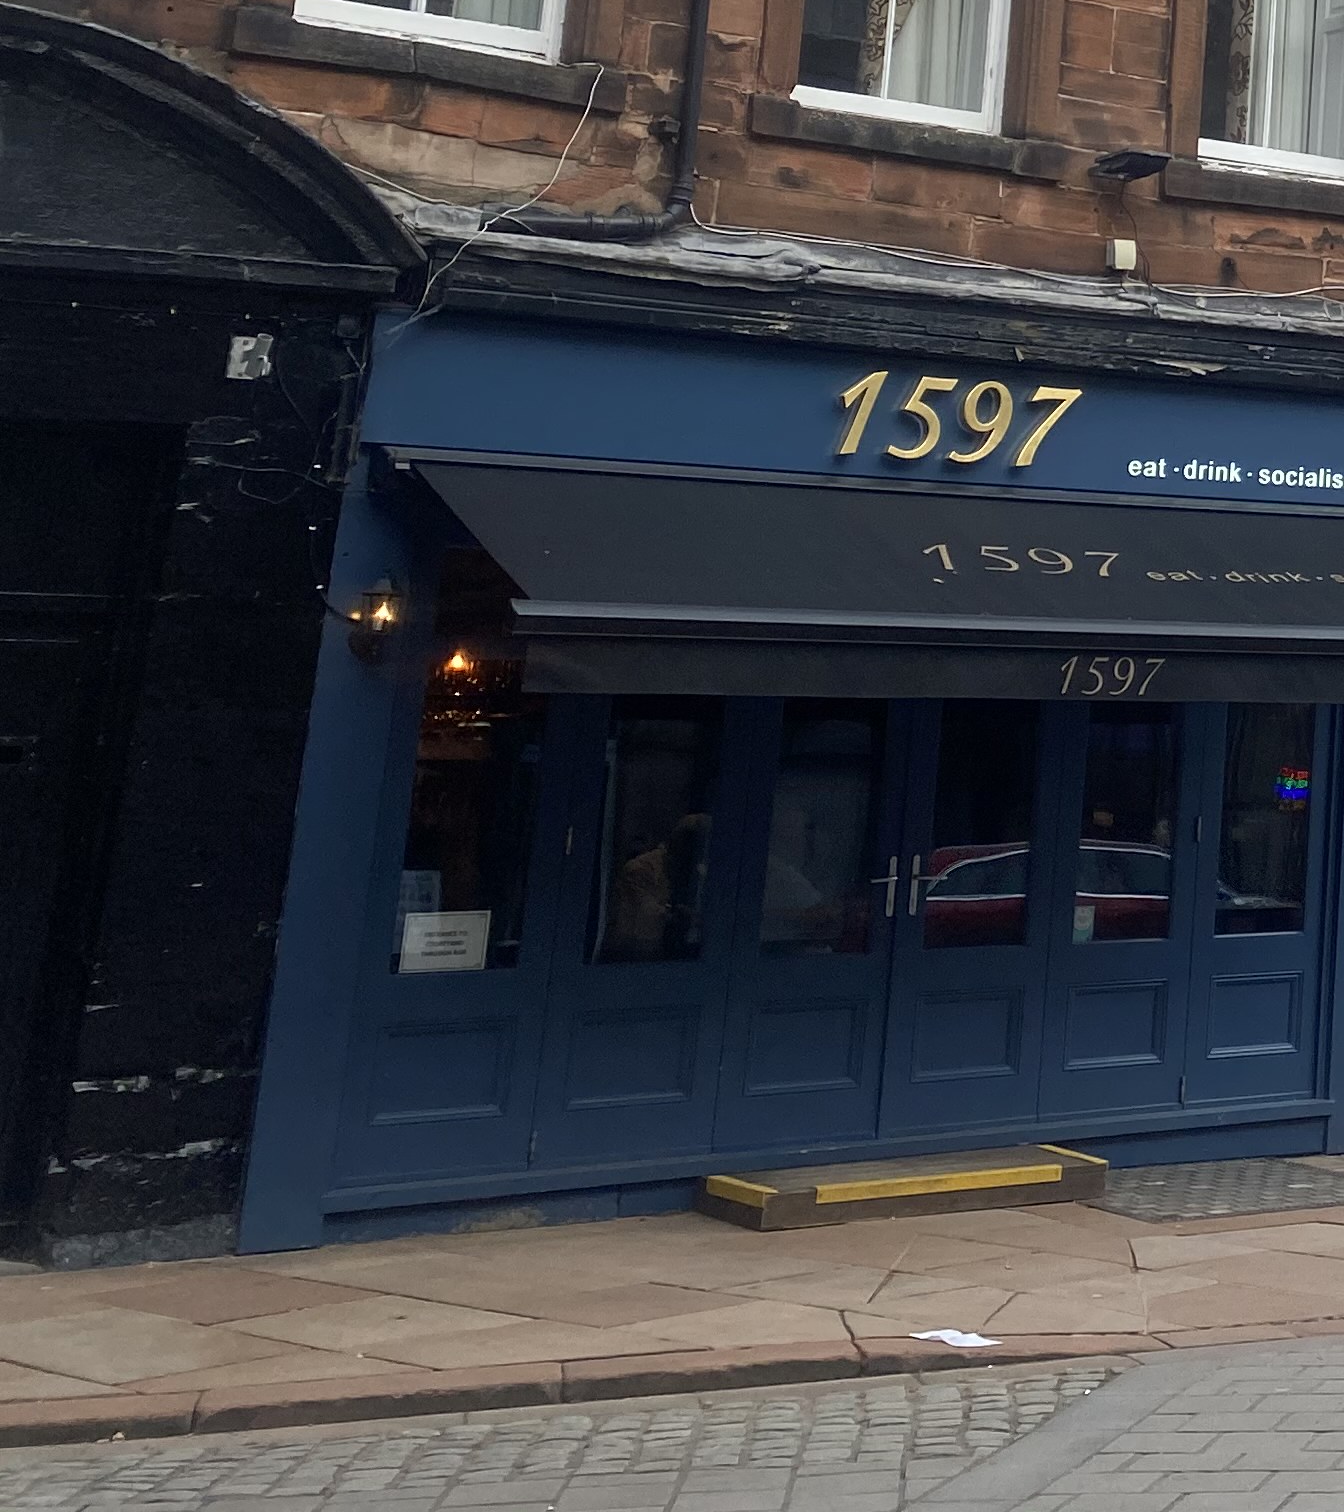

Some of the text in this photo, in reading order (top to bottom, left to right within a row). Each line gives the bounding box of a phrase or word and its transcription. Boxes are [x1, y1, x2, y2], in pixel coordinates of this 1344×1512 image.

[837, 370, 1083, 469] 1597
[1127, 458, 1167, 478] eat
[1183, 459, 1242, 482] drink
[922, 543, 1121, 583] 1597
[1146, 570, 1204, 582] eat
[1224, 570, 1311, 583] drink
[1058, 654, 1166, 696] 1597
